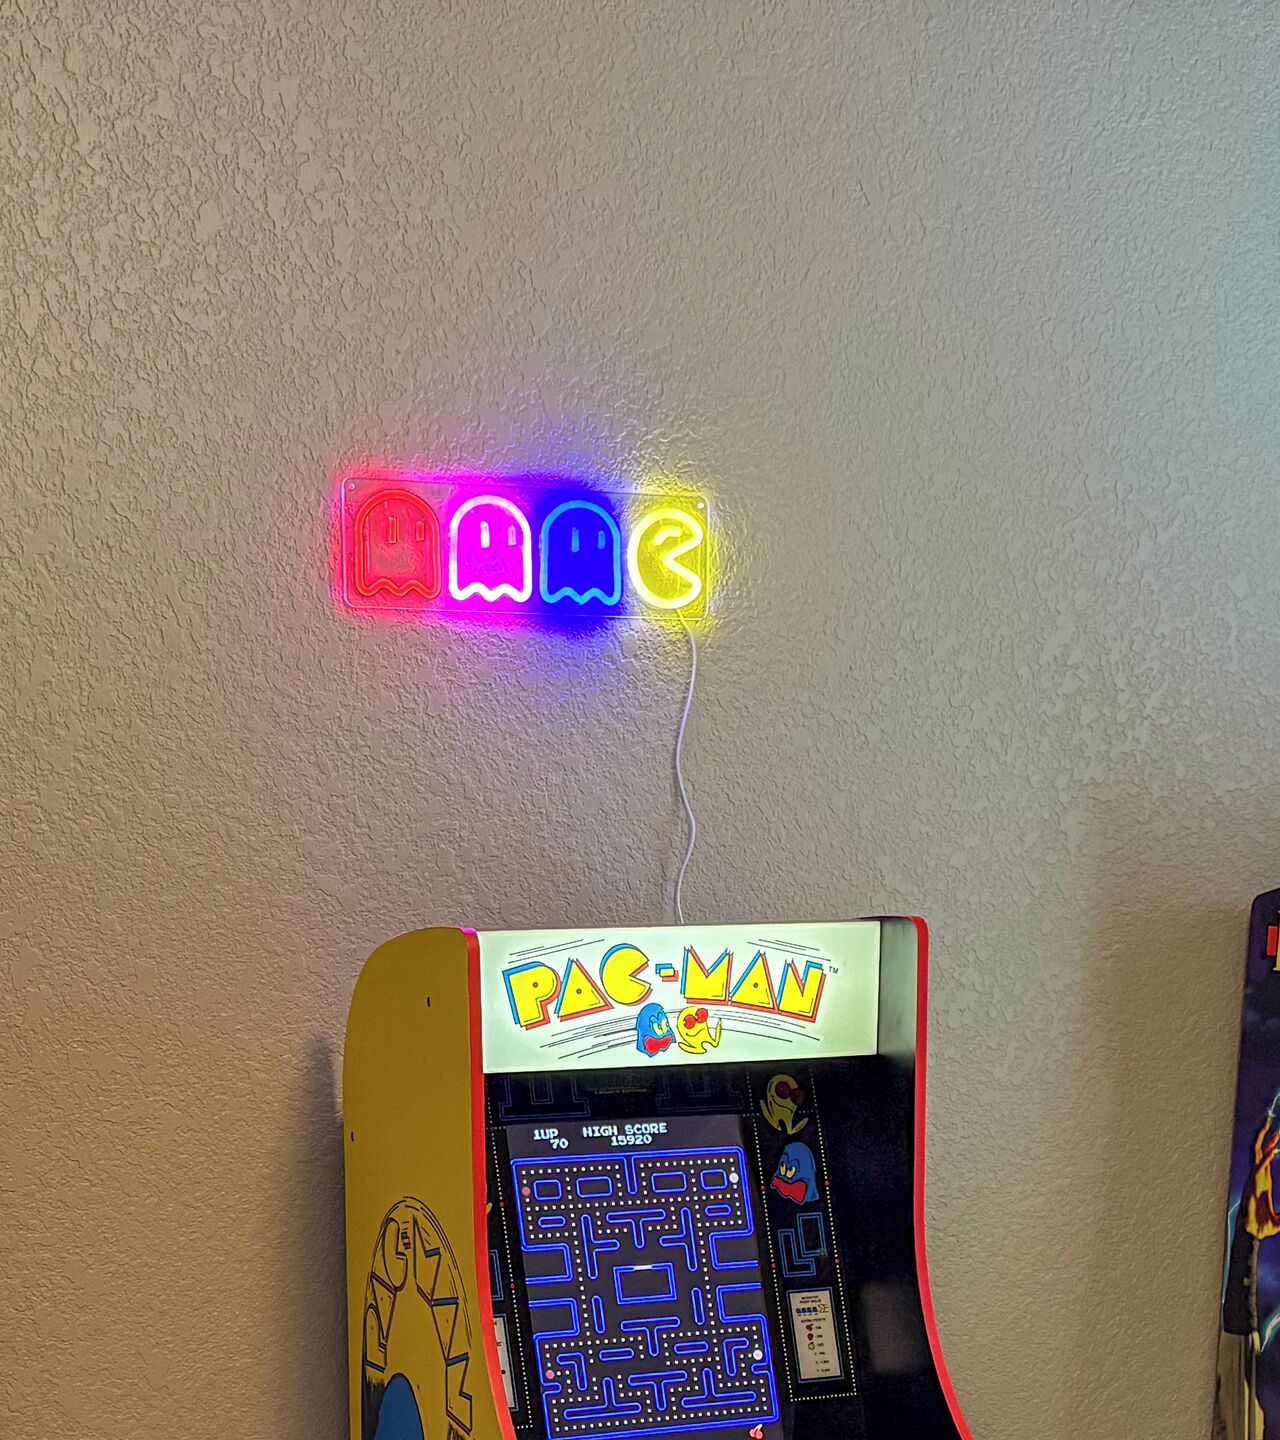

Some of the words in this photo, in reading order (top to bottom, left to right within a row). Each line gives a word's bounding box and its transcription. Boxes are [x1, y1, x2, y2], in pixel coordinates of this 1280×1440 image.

[502, 942, 826, 1031] PAC-MAN
[533, 1128, 559, 1140] 1UP
[582, 1125, 618, 1138] HIGH
[624, 1122, 668, 1135] SCORE
[549, 1138, 569, 1149] 70
[610, 1134, 653, 1147] 15920
